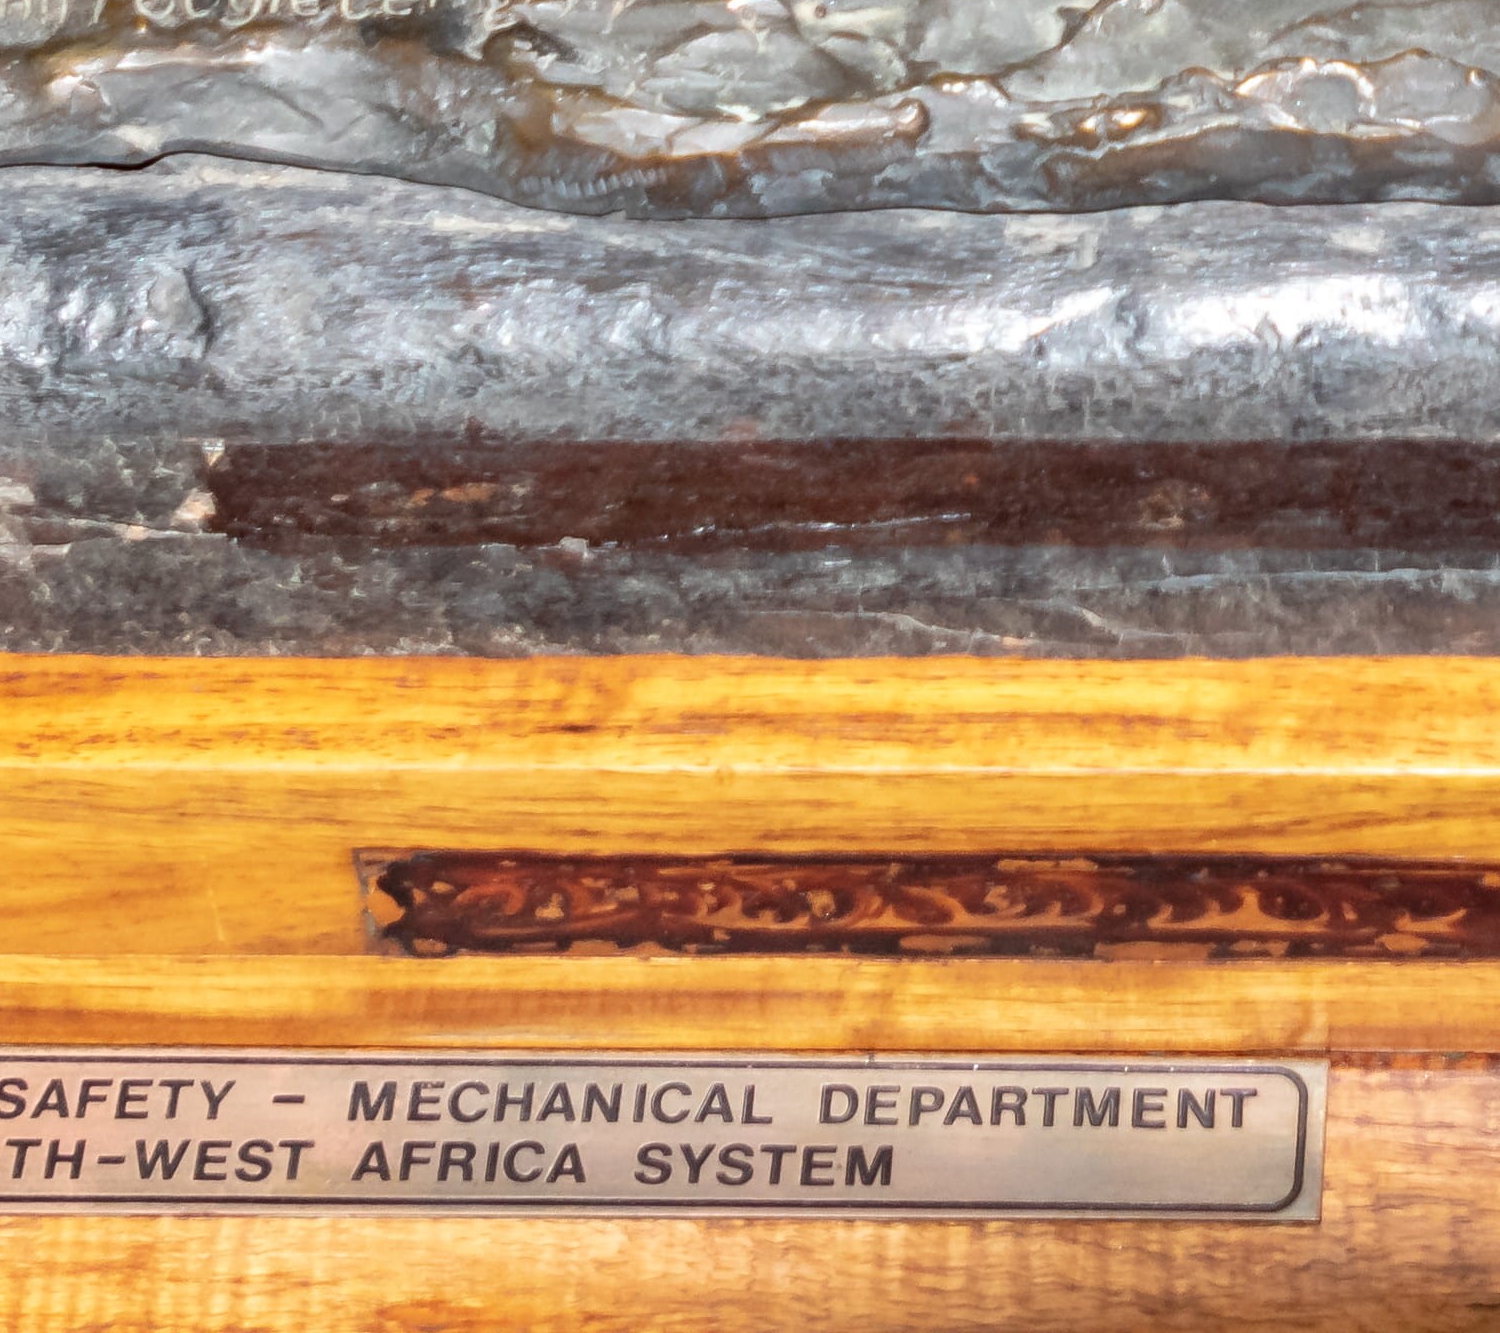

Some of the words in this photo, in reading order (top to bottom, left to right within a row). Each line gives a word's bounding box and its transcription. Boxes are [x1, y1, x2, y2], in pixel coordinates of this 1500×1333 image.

[346, 1079, 774, 1125] MECHANICAL
[818, 1082, 1258, 1129] DEPARTMENT
[351, 1139, 587, 1185] AFRICA
[634, 1141, 894, 1187] SYSTEM
